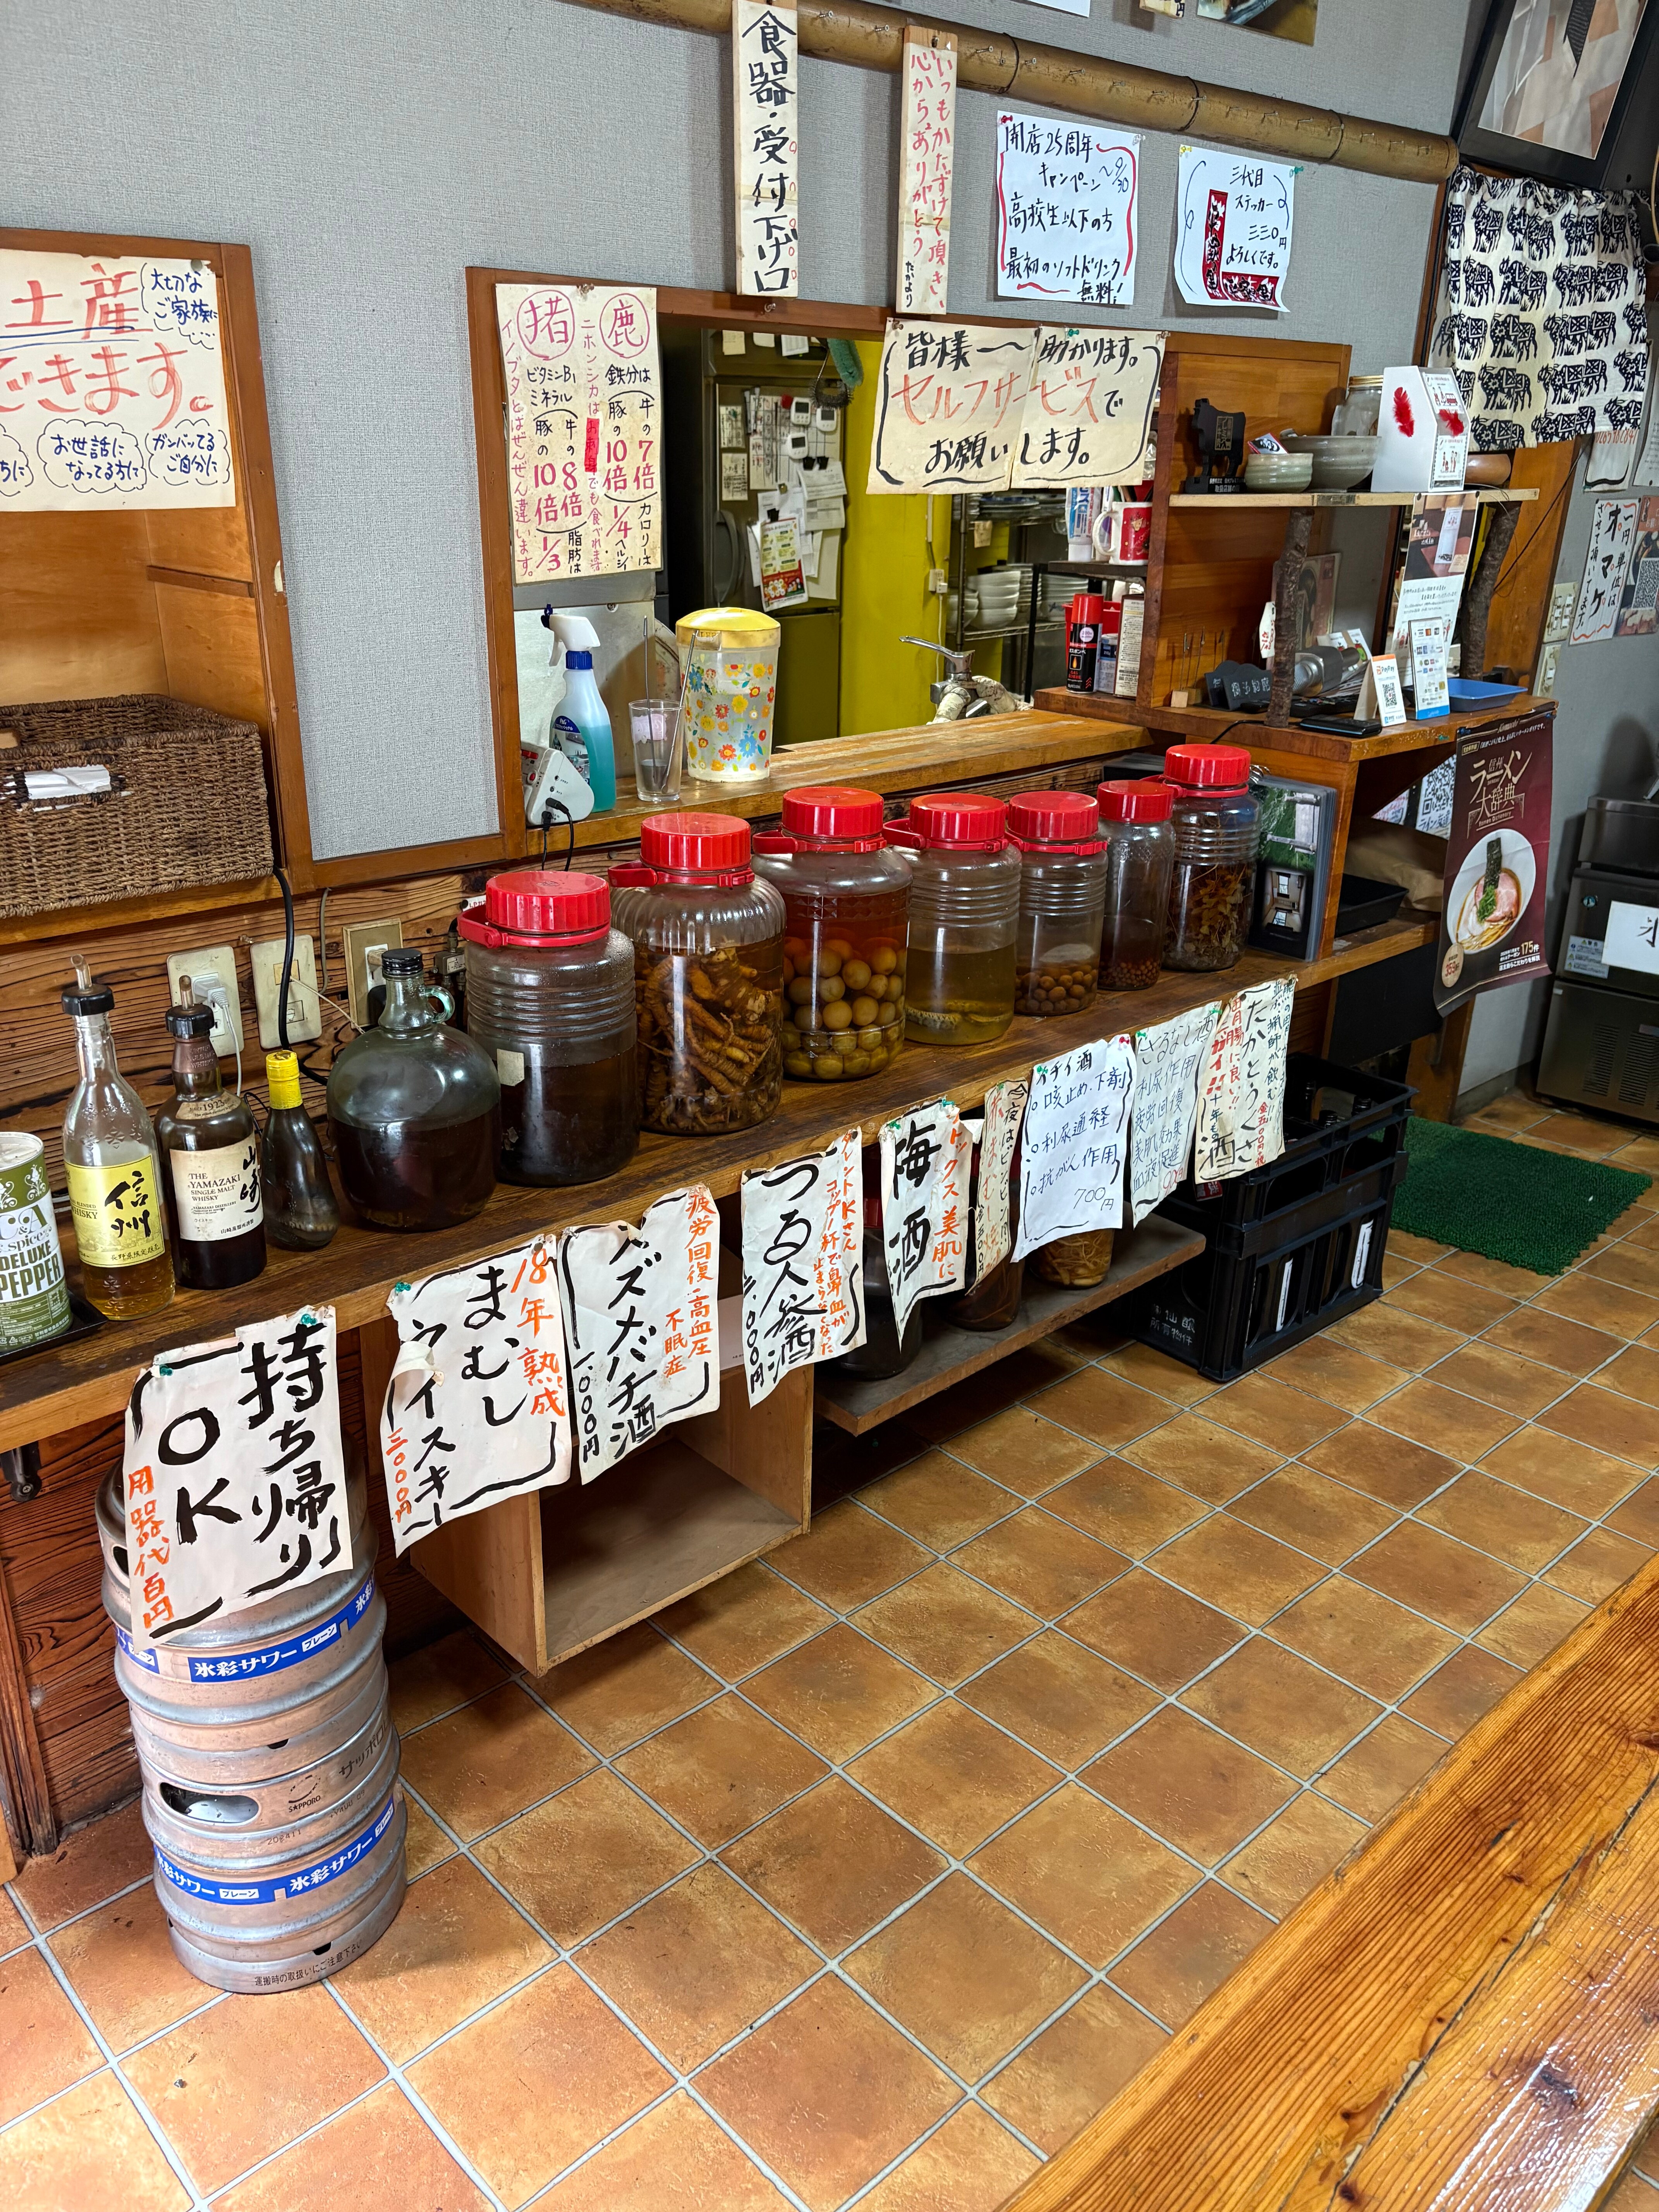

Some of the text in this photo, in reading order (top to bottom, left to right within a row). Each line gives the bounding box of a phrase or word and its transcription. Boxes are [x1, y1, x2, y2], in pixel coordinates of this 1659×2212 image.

[1174, 0, 1185, 17] 円
[1230, 165, 1263, 187] 三代目
[1235, 194, 1273, 211] ステッカー
[151, 269, 202, 291] 大切な
[1006, 247, 1121, 280] 最初のソフトドリンク
[5, 263, 153, 339] 土産
[607, 299, 644, 346] 鹿
[605, 364, 651, 386] 鉄分は
[530, 390, 572, 408] ミネラル
[51, 434, 124, 459] お世話に
[925, 428, 1089, 474] お願いします。
[167, 454, 218, 477] ご自分に
[567, 531, 582, 574] 脂肪は
[1470, 750, 1532, 804] ラーメン
[1489, 756, 1504, 773] 信州
[1475, 783, 1515, 824] 大辞典
[1136, 1054, 1197, 1100] 利尿作用
[203, 1100, 225, 1111] 1923
[1133, 1119, 1183, 1167] 美肌効果
[189, 1174, 240, 1189] YAMAZAKI
[218, 1185, 235, 1193] MALT
[105, 1171, 151, 1238] 信州
[1073, 1187, 1114, 1211] 700円
[0, 1240, 52, 1271] DELUXE
[0, 1253, 60, 1300] PEPPER
[461, 1266, 527, 1426] まむし
[663, 1308, 687, 1378] 不眠症
[195, 1626, 335, 1677] 氷彩サワー プレーン
[290, 1837, 373, 1893] 氷彩サワー
[223, 1890, 257, 1898] プレーン
[254, 1942, 361, 1986] 運搬時の取扱いにご注意下さい
